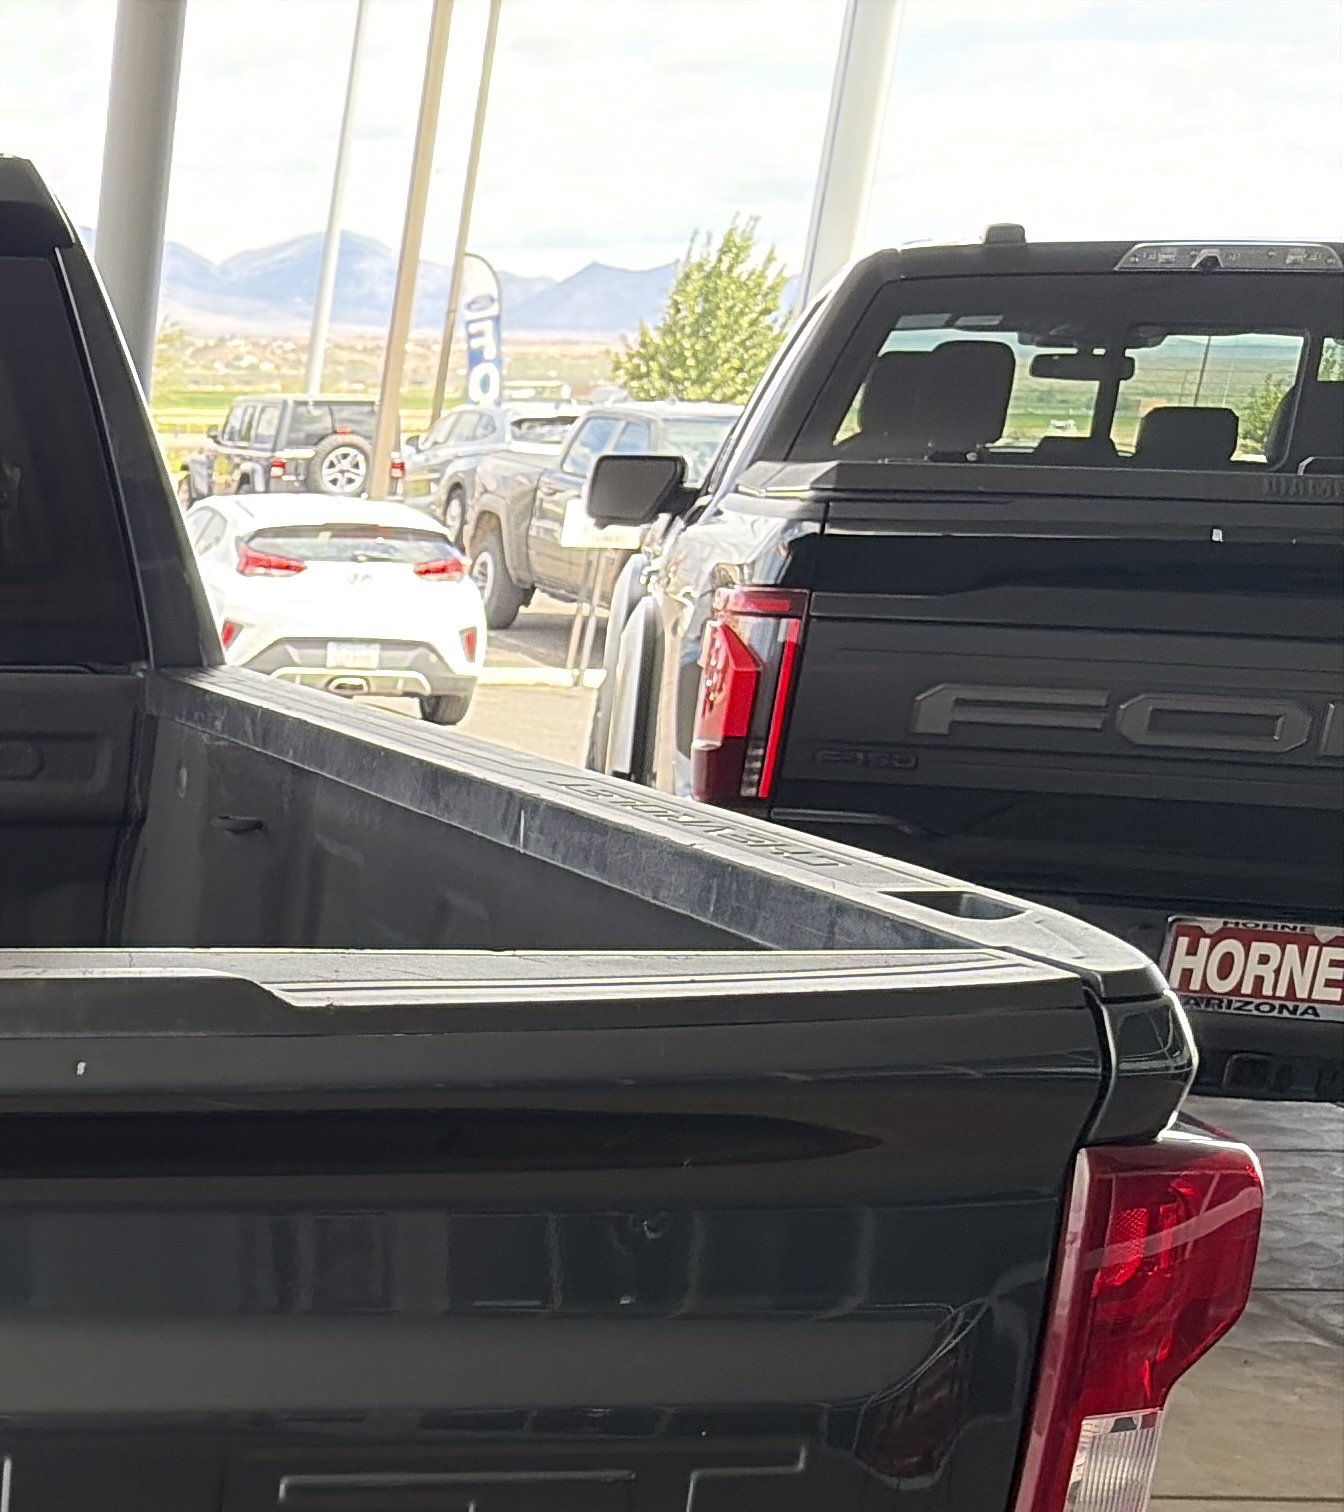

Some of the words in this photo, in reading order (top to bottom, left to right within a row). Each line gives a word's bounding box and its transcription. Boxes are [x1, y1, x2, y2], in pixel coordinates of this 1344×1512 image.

[912, 684, 1344, 756] FO
[1169, 936, 1344, 1002] HORNE
[1183, 996, 1321, 1018] ARIZONA
